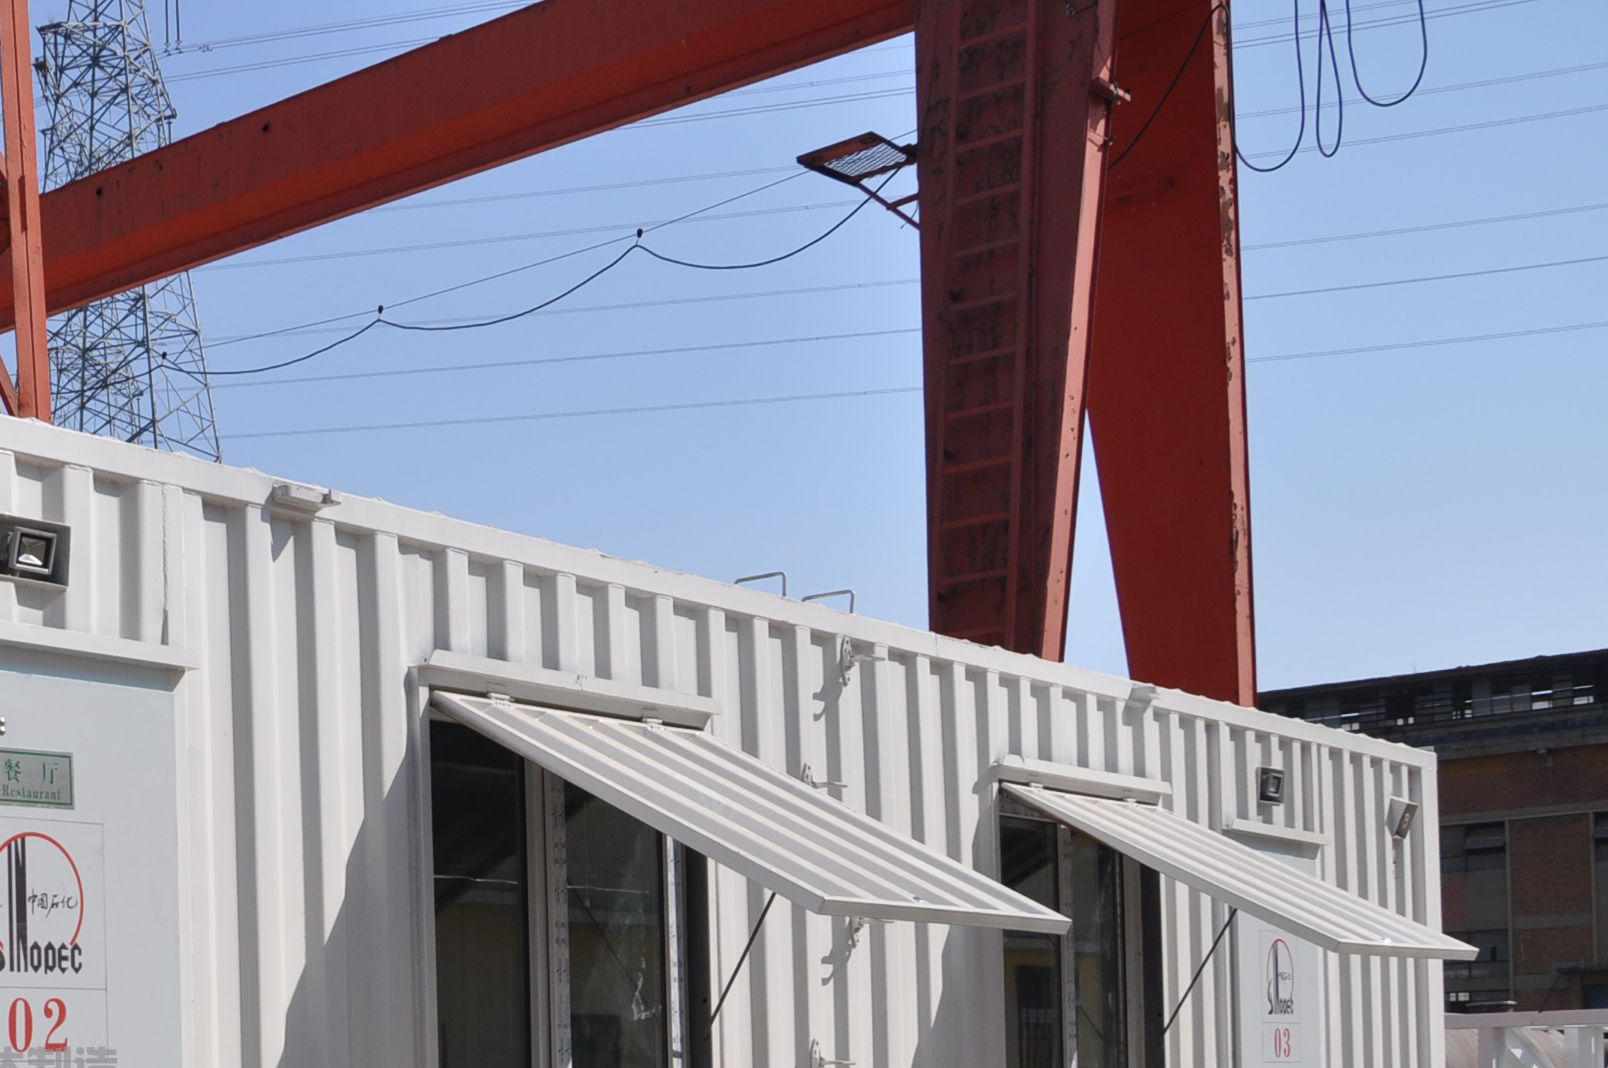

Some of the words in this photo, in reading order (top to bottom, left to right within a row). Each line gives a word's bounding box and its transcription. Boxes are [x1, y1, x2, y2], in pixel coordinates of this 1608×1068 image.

[3, 758, 59, 785] 餐厅
[2, 783, 61, 801] Restaurant
[28, 888, 79, 918] 中国石化
[8, 997, 69, 1053] 02
[1274, 1027, 1292, 1058] 03
